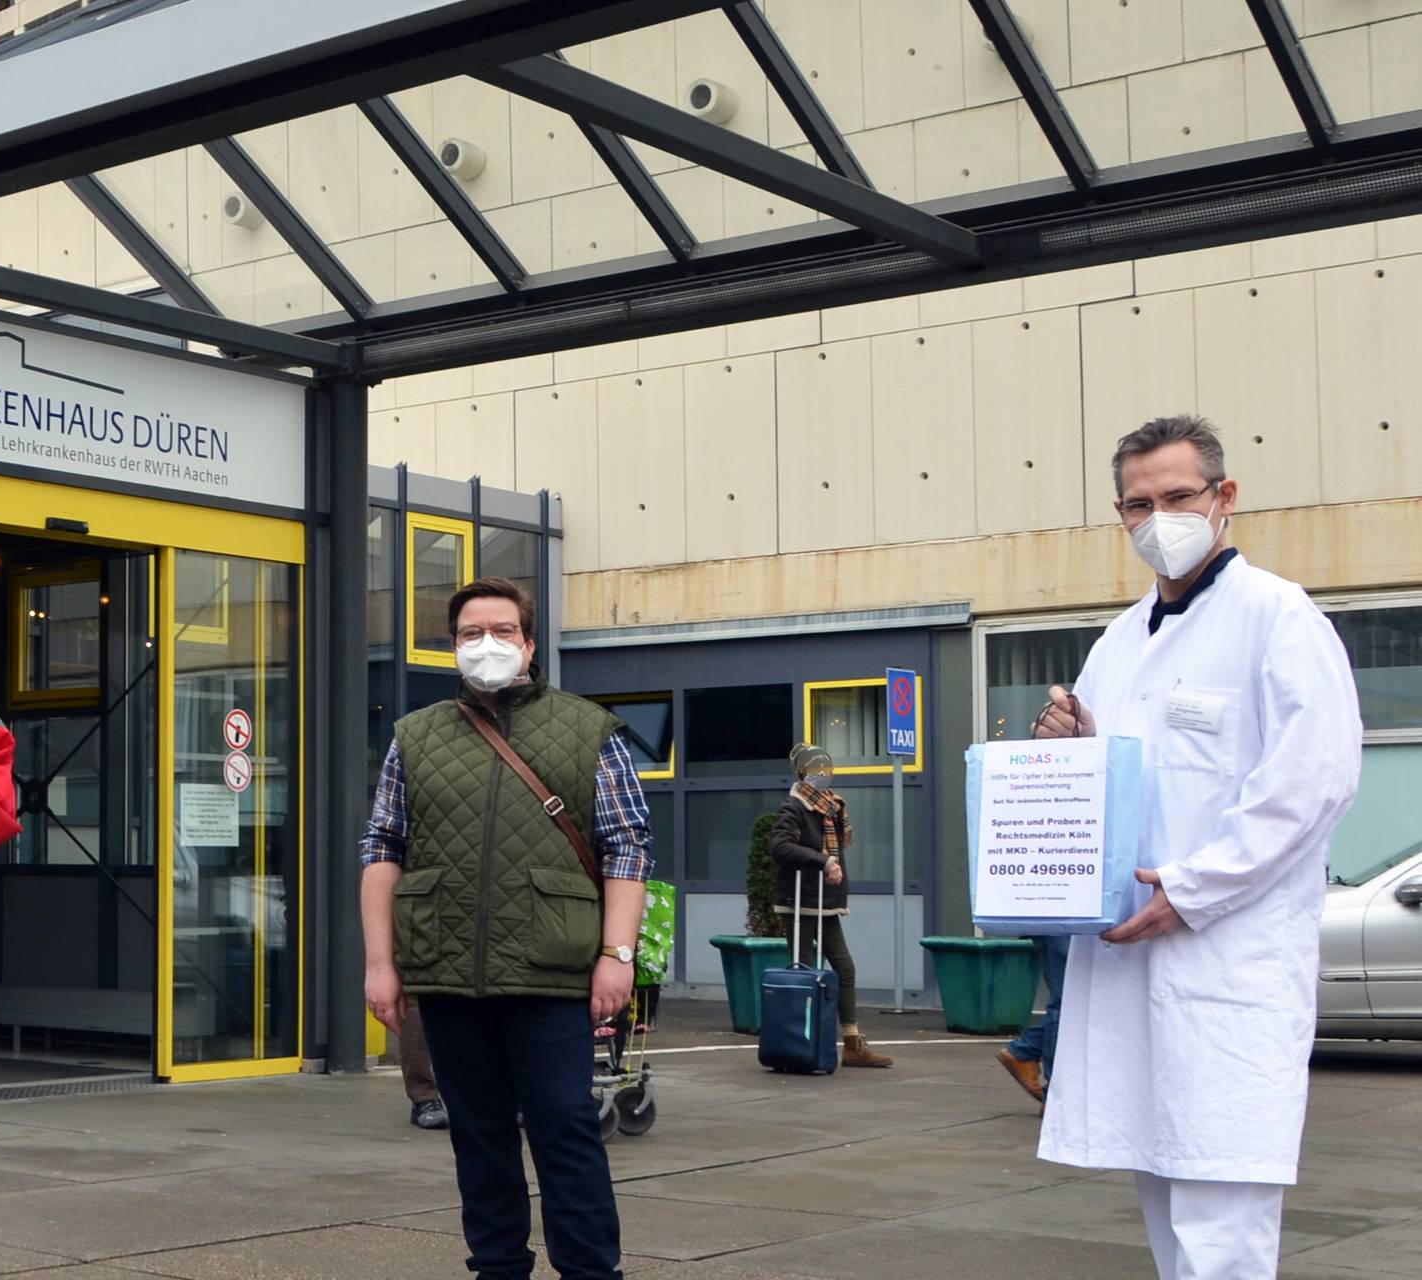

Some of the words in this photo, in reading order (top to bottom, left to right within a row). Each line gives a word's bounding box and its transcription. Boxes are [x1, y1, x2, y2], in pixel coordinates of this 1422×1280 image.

[133, 413, 229, 463] DÜREN
[1, 437, 117, 469] Lehrkrankenhaus
[119, 457, 141, 472] der
[144, 458, 181, 478] RWTH
[183, 465, 229, 487] Aachen
[891, 729, 914, 747] TAXI
[1010, 754, 1052, 765] HObAS
[1022, 773, 1041, 781] Opfer
[1057, 772, 1094, 780] Anonymer
[1010, 782, 1071, 791] Spurensicherung
[991, 818, 1025, 827] Spuren
[1027, 818, 1044, 826] und
[1047, 818, 1081, 826] Proben
[996, 831, 1066, 840] Rechtsmedizin
[1068, 831, 1091, 839] Köln
[987, 847, 1003, 855] mit
[1006, 847, 1028, 855] MKD
[1038, 847, 1099, 855] Kurierdienst
[989, 864, 1025, 875] 0800
[1030, 863, 1095, 875] 4969690
